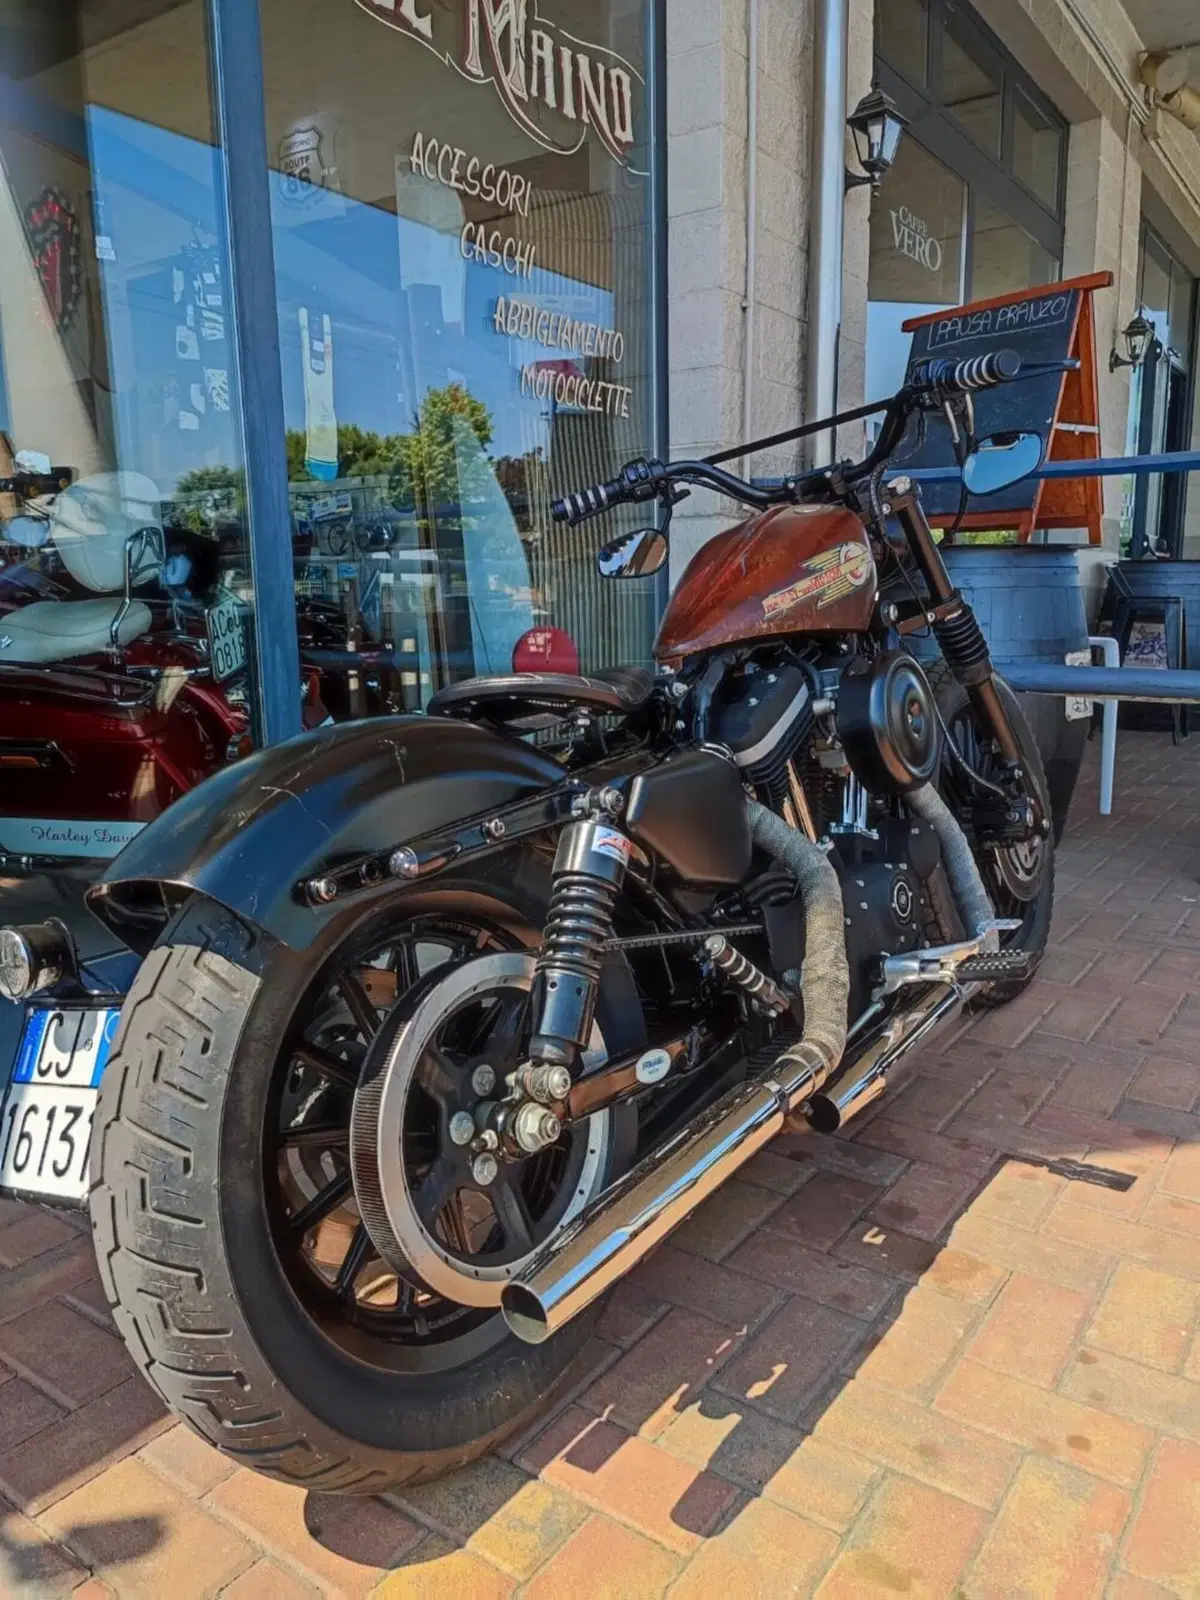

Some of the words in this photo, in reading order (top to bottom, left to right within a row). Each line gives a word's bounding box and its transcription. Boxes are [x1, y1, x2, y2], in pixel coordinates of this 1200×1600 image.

[410, 131, 532, 217] ACCESSORI
[460, 222, 536, 279] CASCHI
[889, 210, 942, 272] VERO
[493, 296, 625, 363] ABBIGLIAMENTO
[935, 310, 992, 342] PAUSA
[995, 296, 1066, 331] PRANZO
[519, 364, 633, 419] MOTOCICLETTE
[30, 826, 92, 846] Harley
[37, 1011, 86, 1078] CJ
[0, 1102, 94, 1183] 16131
